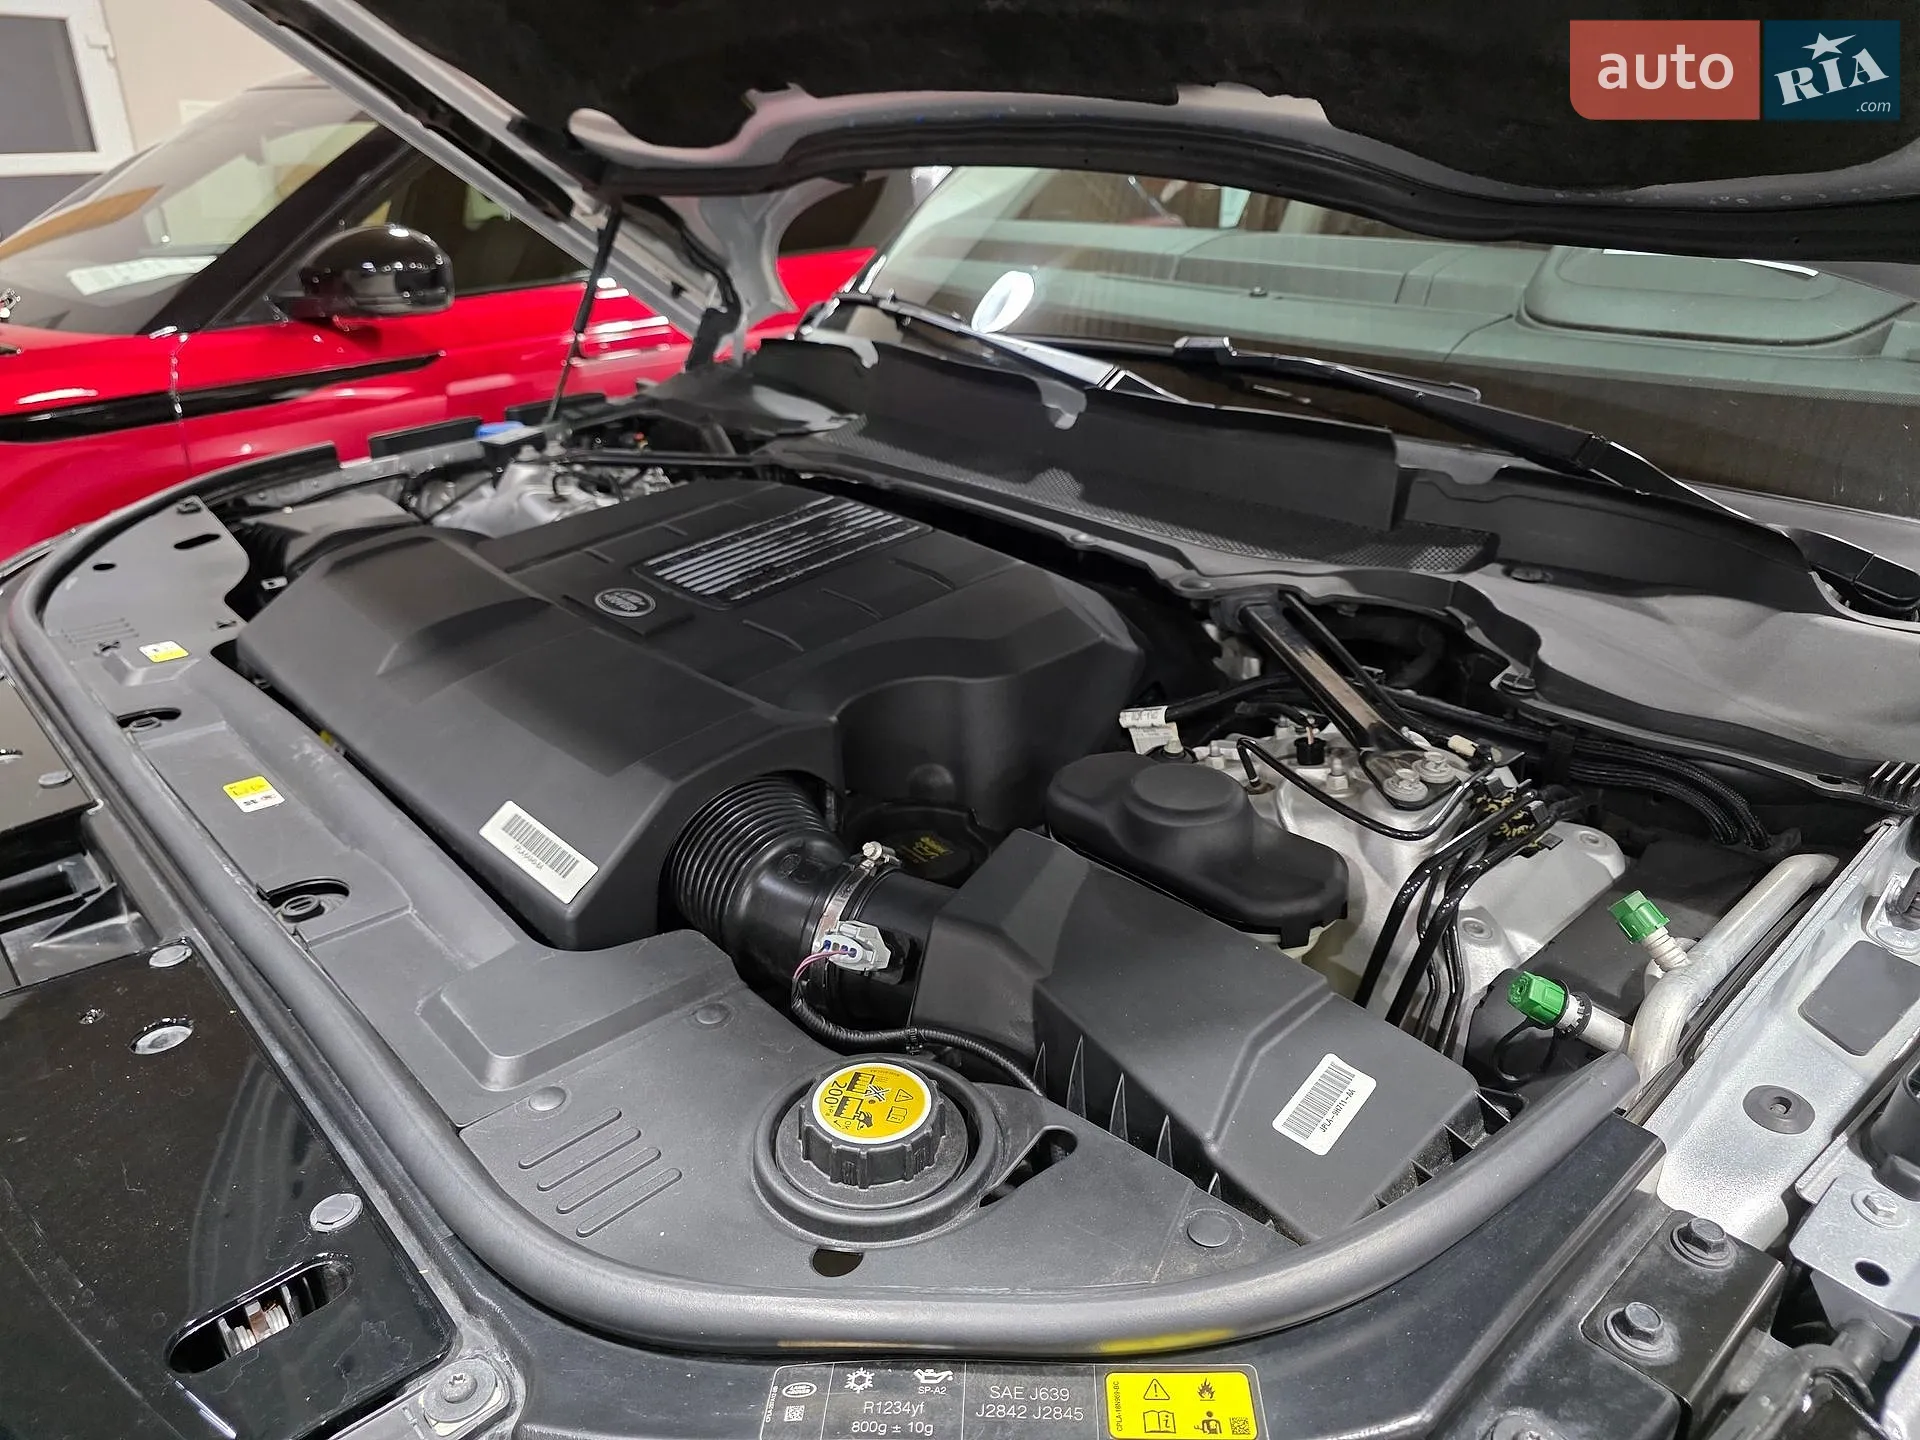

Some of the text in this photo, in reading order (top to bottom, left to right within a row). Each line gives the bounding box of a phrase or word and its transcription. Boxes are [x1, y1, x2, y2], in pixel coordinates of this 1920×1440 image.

[824, 1080, 847, 1105] 200
[918, 1386, 947, 1395] SP-A2
[990, 1385, 1070, 1401] SAE J639
[863, 1401, 925, 1416] R1234yf
[976, 1404, 1084, 1421] J2842 J2845
[851, 1421, 934, 1437] 800g ± 10g
